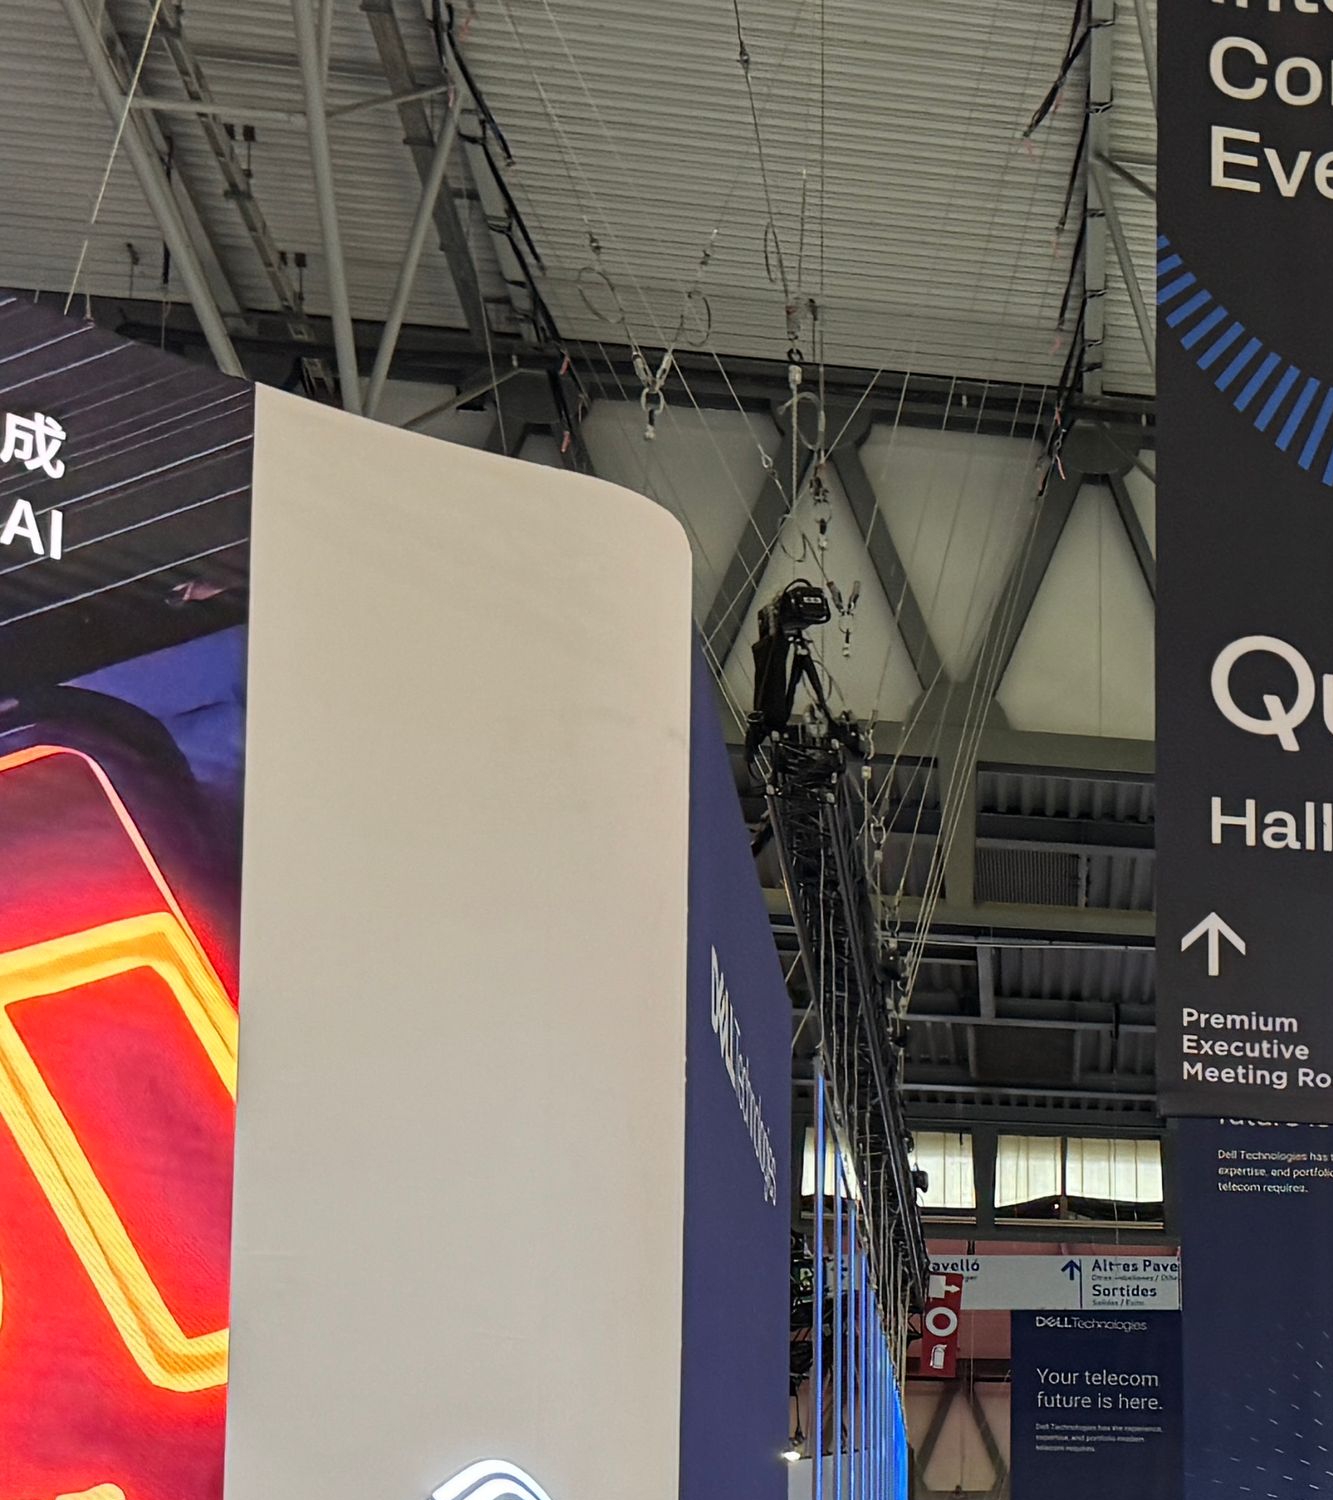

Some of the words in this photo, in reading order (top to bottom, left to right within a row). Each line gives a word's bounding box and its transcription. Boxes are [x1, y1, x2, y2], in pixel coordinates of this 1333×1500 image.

[1211, 797, 1333, 852] Hall
[1182, 1007, 1298, 1032] Premium
[1182, 1034, 1310, 1060] Executive
[1182, 1061, 1288, 1089] Meeting
[1217, 1150, 1237, 1159] Dell
[1309, 1152, 1328, 1162] has
[1092, 1284, 1157, 1297] Sortides
[1036, 1368, 1079, 1385] Your
[1085, 1369, 1159, 1387] telecom
[1037, 1391, 1092, 1408] future
[1098, 1393, 1113, 1408] is
[1118, 1394, 1163, 1410] here.
